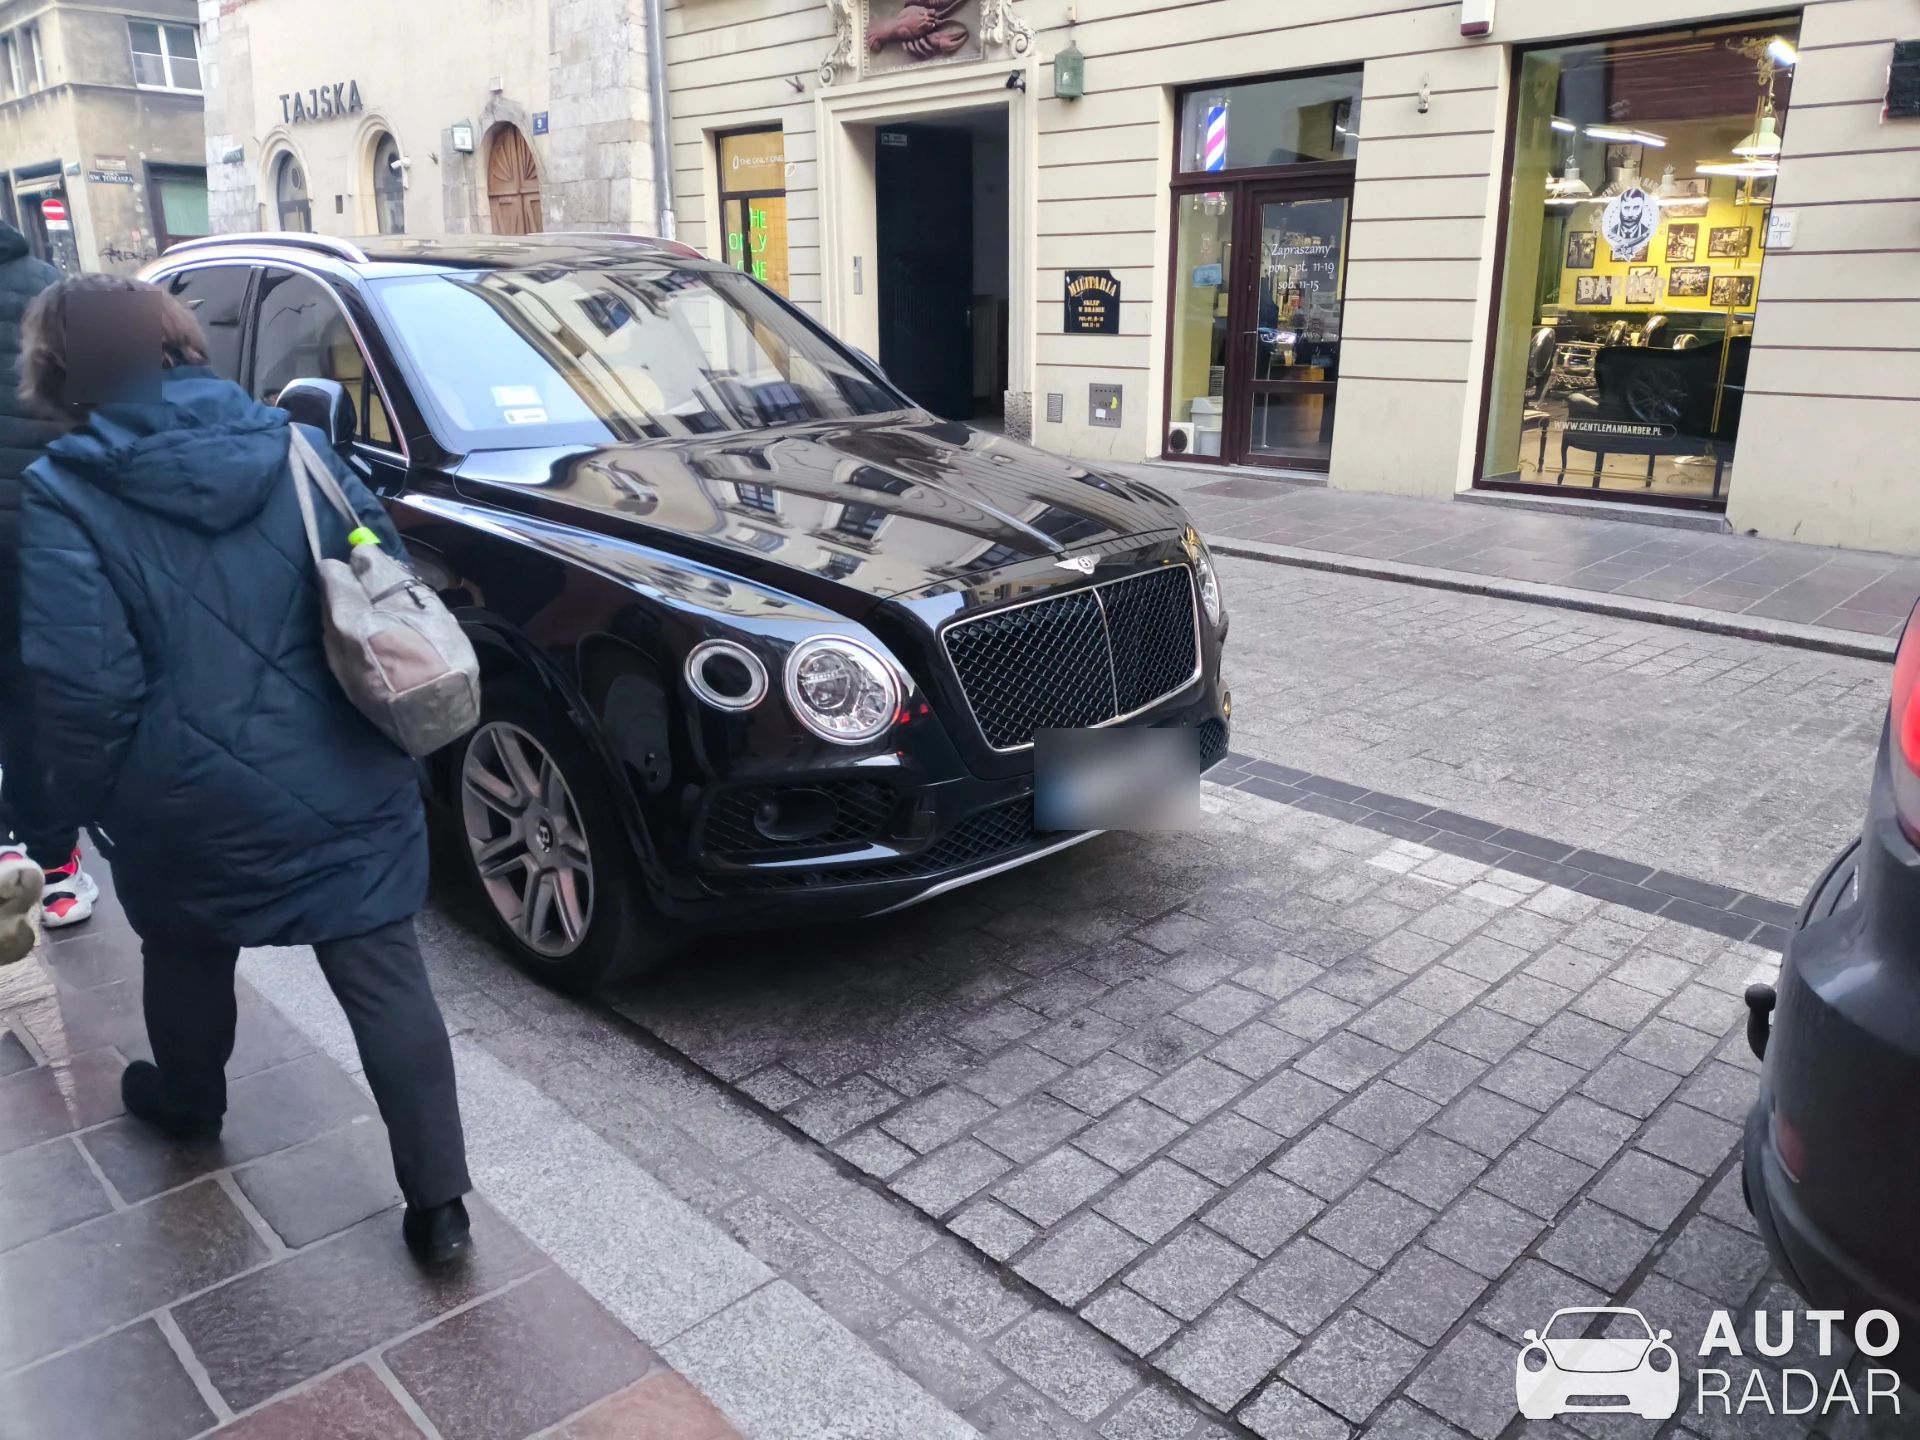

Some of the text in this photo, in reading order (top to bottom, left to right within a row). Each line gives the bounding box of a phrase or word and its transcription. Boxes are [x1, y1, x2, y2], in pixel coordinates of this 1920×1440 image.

[279, 79, 363, 124] TAJSKA
[1271, 243, 1332, 260] Zapraszamy
[1313, 262, 1335, 274] 11-19
[1067, 275, 1117, 297] MILITARIA
[1277, 280, 1319, 291] sob. 11-15
[1580, 275, 1666, 299] BARBER
[1553, 420, 1662, 436] WWW.GENTLEMANBARBER.PL
